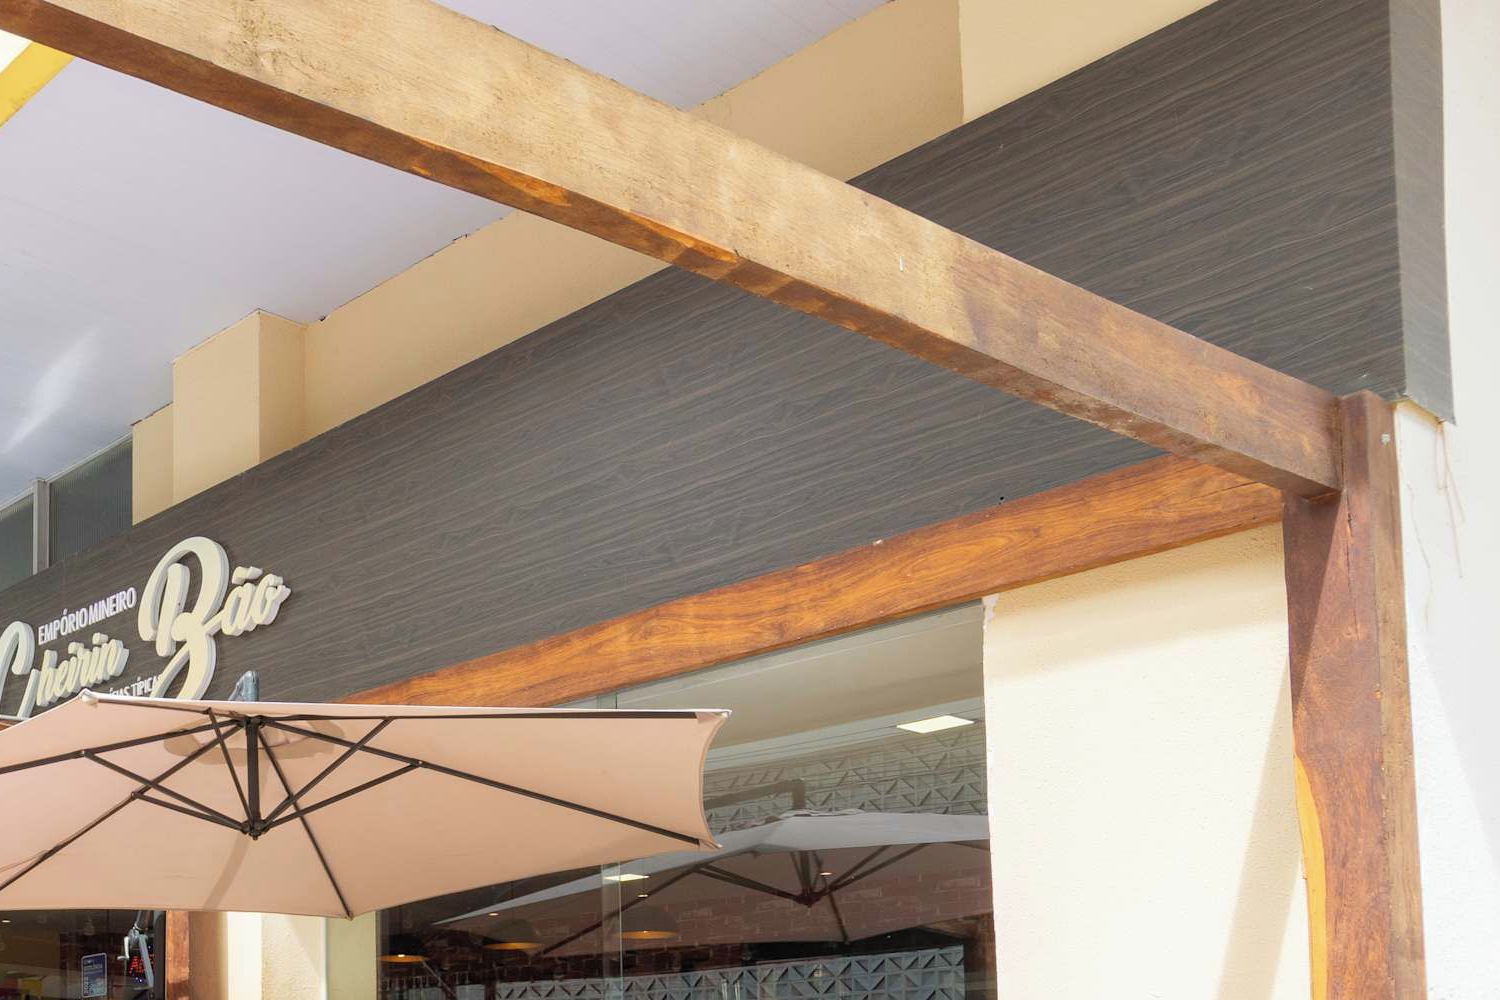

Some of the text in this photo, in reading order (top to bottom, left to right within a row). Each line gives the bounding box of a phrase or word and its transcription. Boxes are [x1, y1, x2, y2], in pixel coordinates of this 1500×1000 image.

[37, 587, 138, 646] EMPÓRIO MINEIRO
[138, 536, 292, 700] Bão
